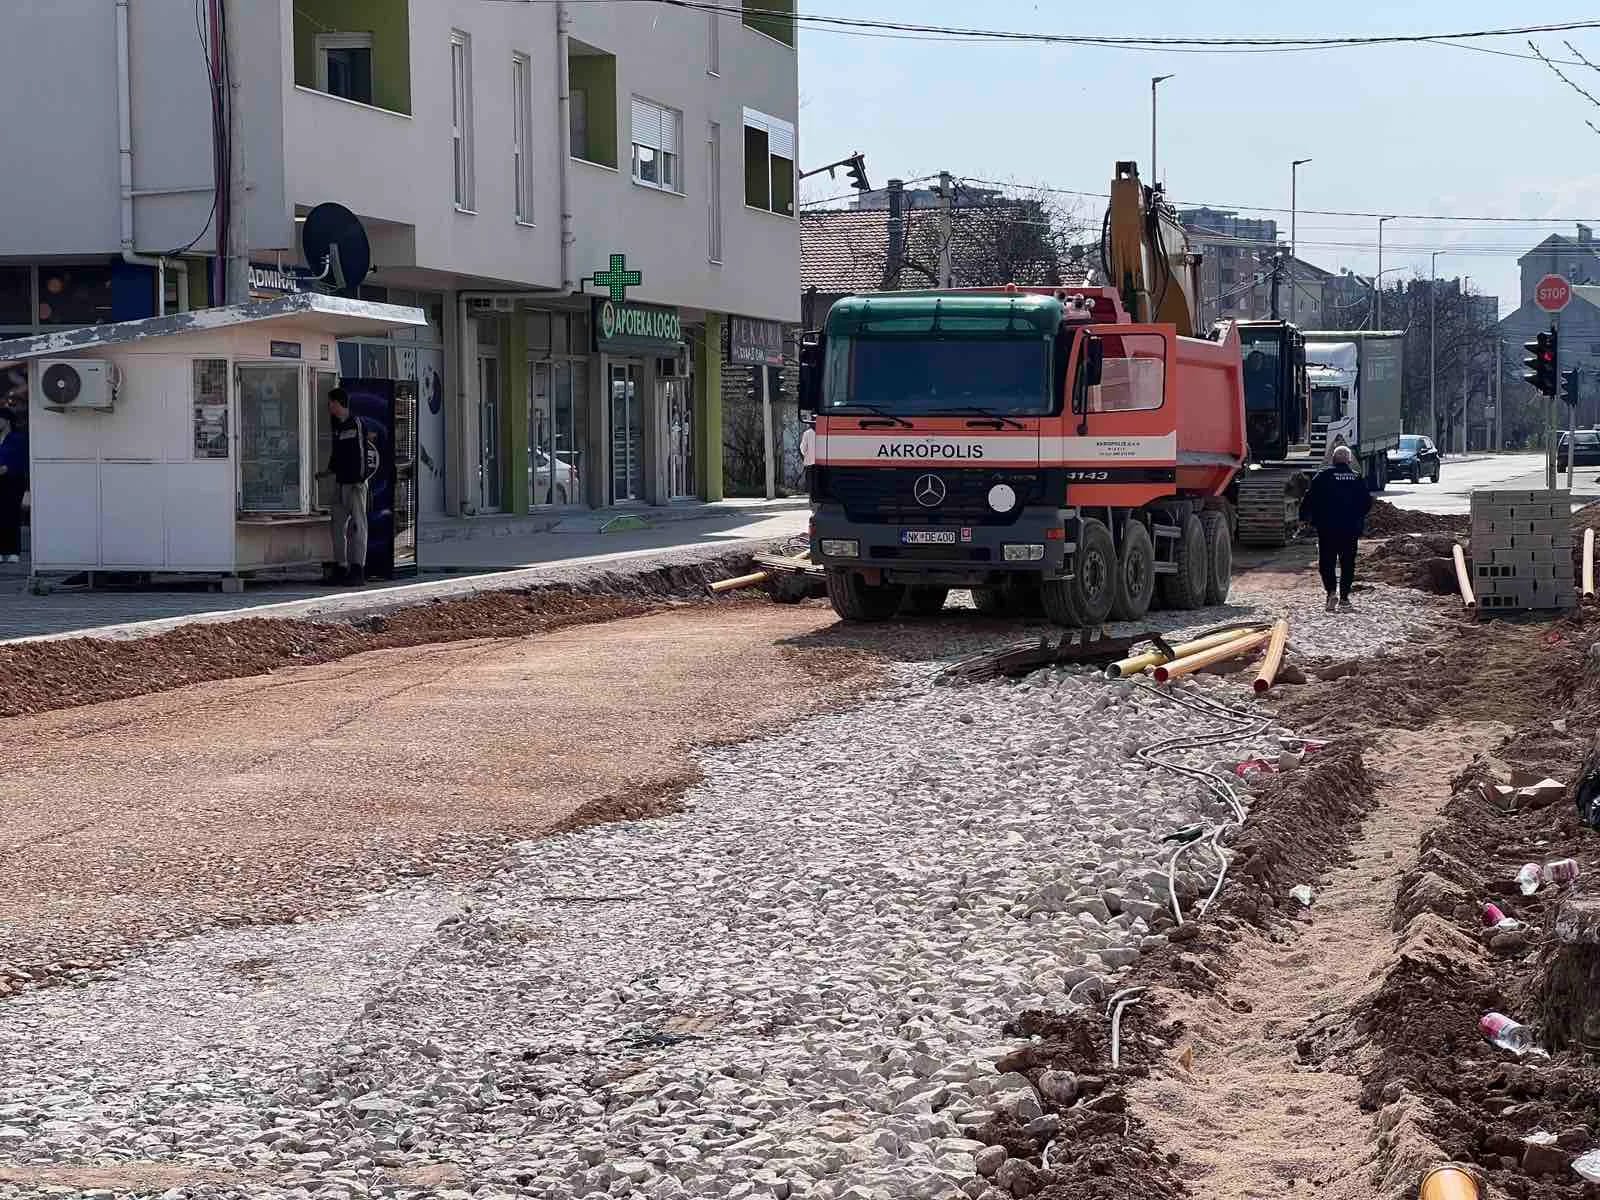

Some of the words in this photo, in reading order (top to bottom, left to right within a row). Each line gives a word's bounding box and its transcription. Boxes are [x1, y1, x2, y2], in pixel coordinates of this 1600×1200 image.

[248, 265, 301, 292] ADMIRAL
[1539, 287, 1567, 300] STOP
[615, 308, 652, 336] APOTEKA
[653, 312, 681, 340] LOGOS
[877, 443, 984, 459] AKROPOLIS
